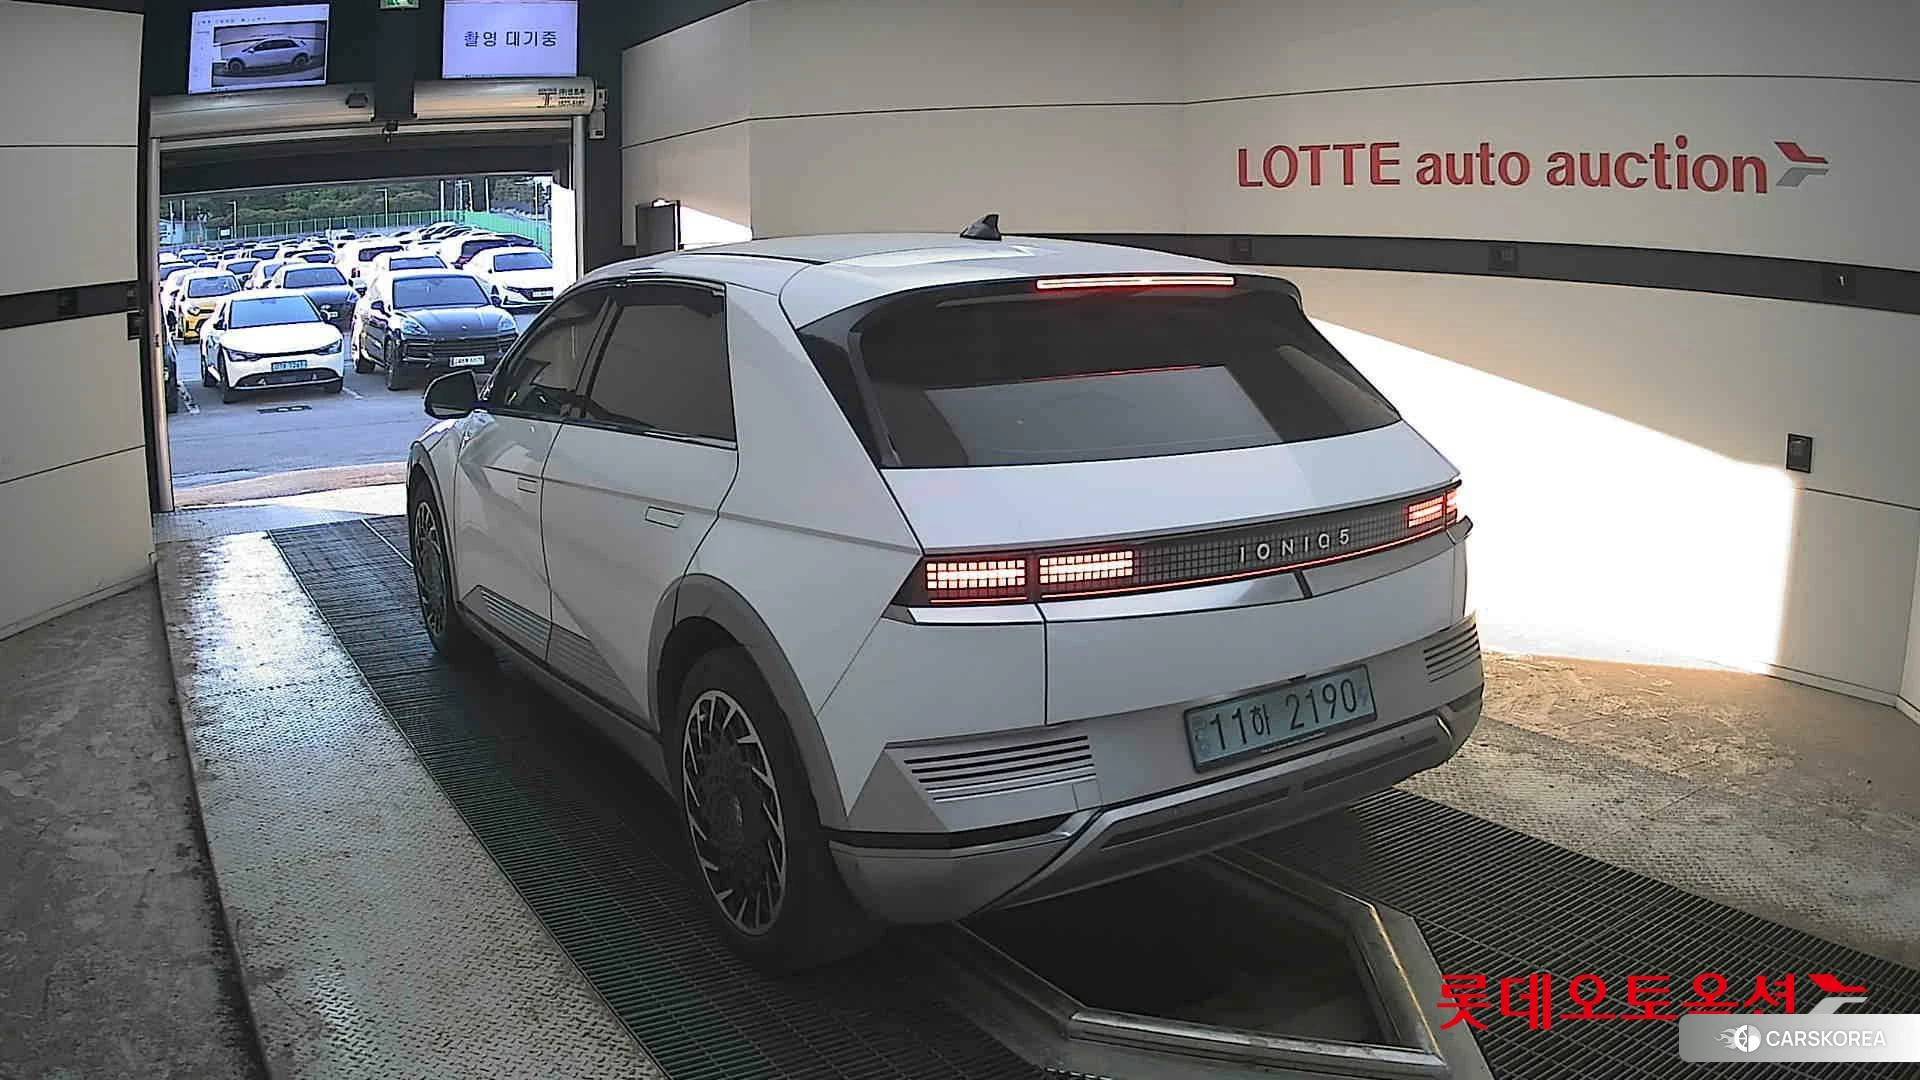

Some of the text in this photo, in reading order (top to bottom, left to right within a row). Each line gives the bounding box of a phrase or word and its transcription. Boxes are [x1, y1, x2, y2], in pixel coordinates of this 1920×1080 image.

[464, 31, 557, 48] 촬영 대기중
[1238, 135, 1767, 193] LOTTE auto auction
[1209, 679, 1358, 751] 11하 2190
